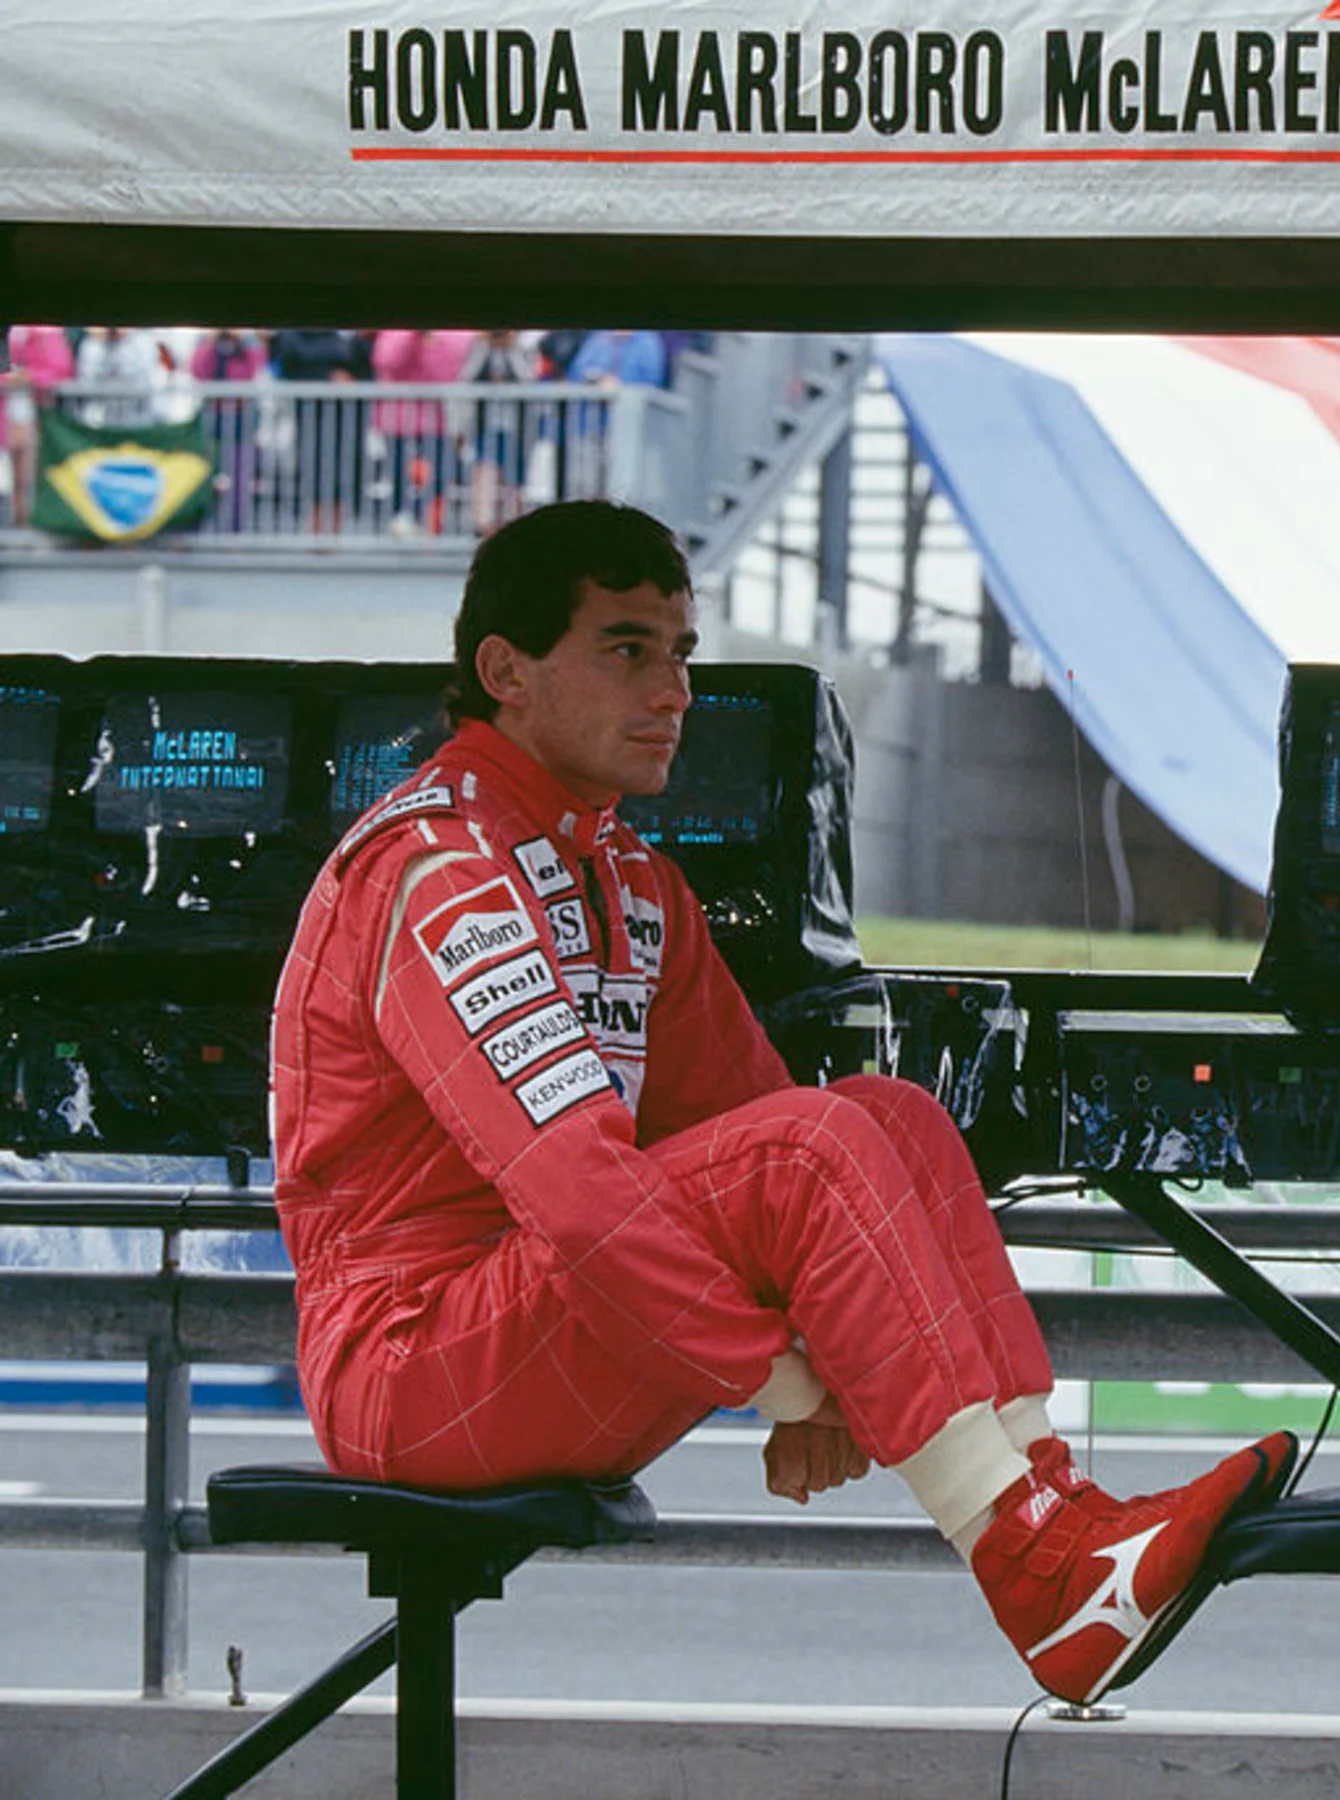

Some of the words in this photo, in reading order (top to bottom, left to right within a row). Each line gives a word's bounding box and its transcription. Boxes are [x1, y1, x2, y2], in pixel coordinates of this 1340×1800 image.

[349, 29, 588, 132] HONDA
[622, 29, 1002, 135] MARLBORO
[153, 731, 236, 760] McLAREN
[439, 920, 523, 973] Marlboro
[465, 963, 547, 1015] Shell
[491, 1008, 580, 1067] COURTAULDS
[527, 1060, 602, 1107] KENWOOD
